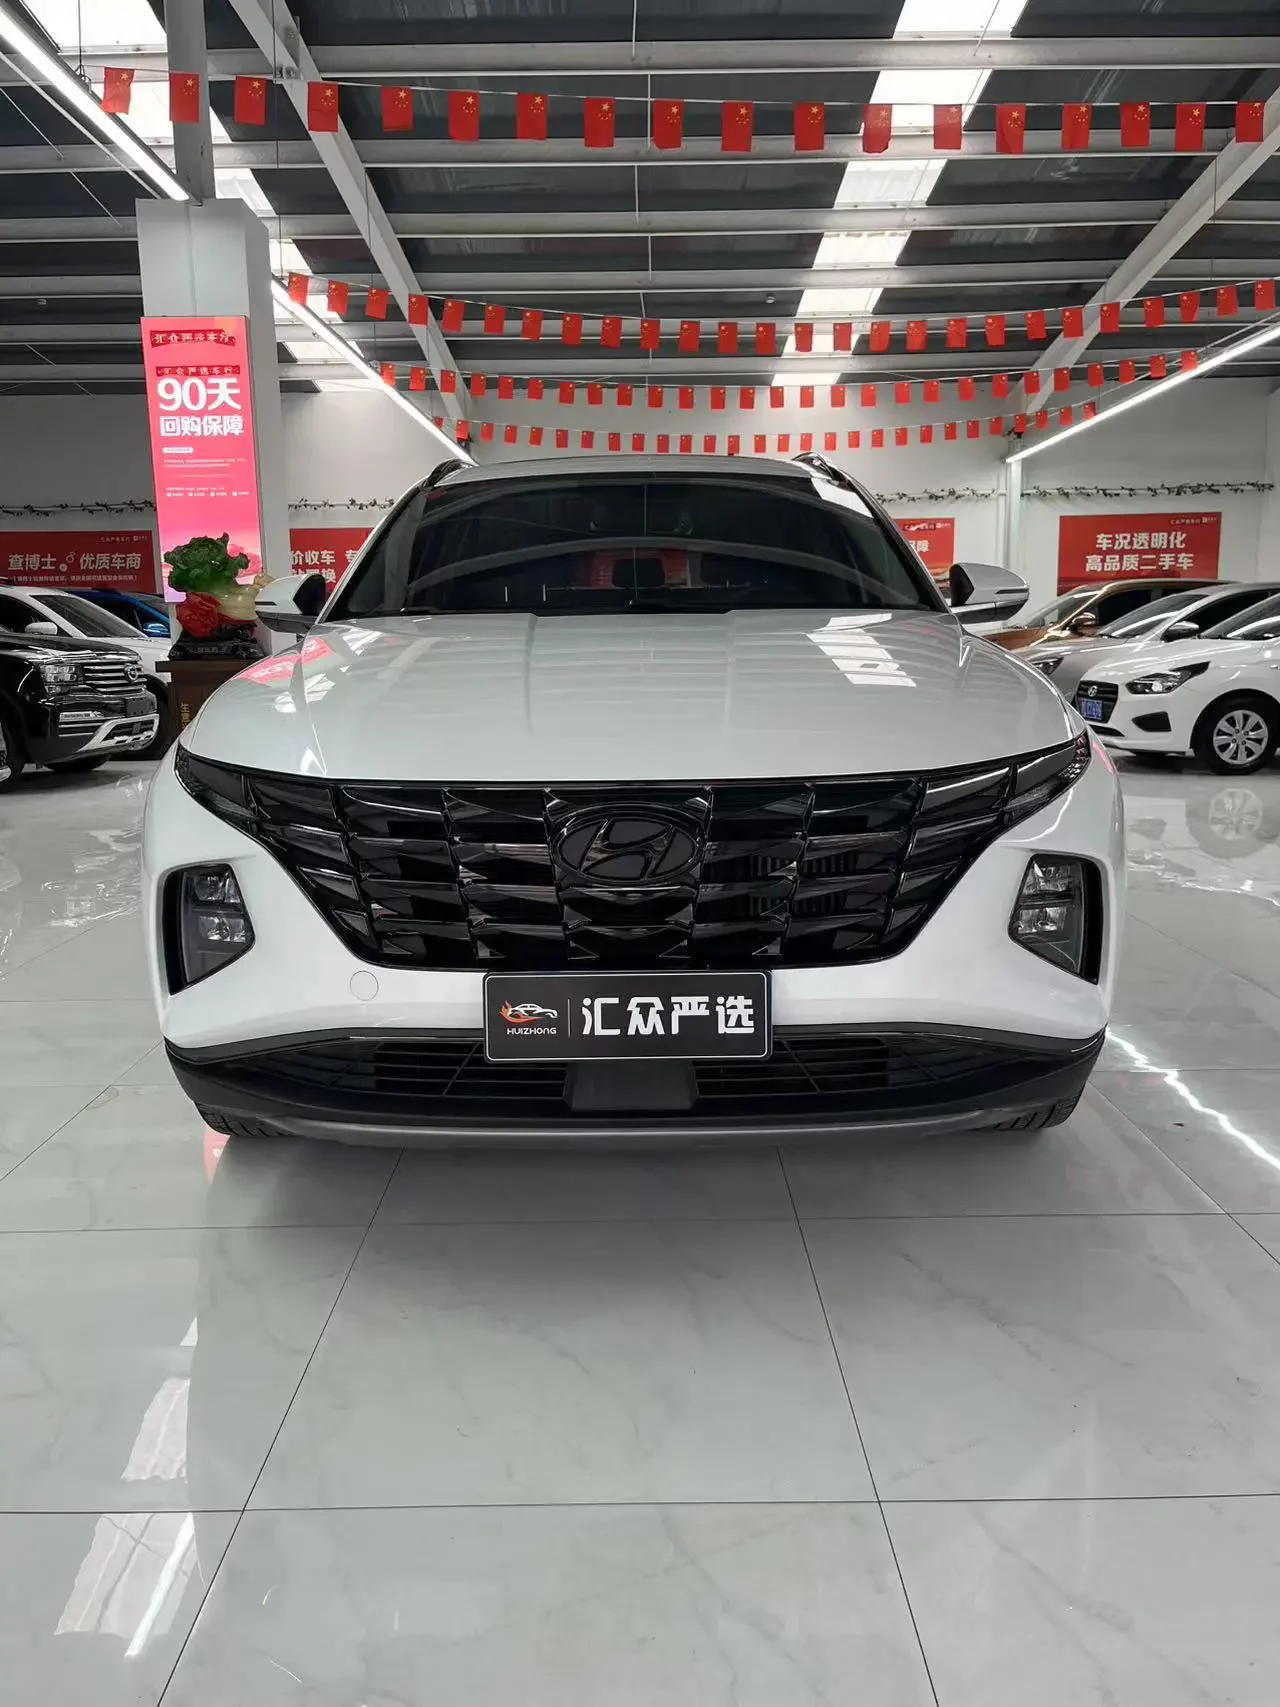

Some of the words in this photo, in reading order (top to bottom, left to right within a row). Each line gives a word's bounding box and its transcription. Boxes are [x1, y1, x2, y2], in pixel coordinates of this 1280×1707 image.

[157, 377, 242, 411] 90天
[160, 414, 244, 437] 回购保障
[1096, 532, 1187, 550] 车况透明化
[8, 554, 57, 571] 查博士
[79, 553, 142, 570] 优质车商
[1086, 553, 1194, 572] 高品质二手车
[581, 996, 755, 1036] 汇众严选
[506, 1027, 557, 1035] HUIZHONG
